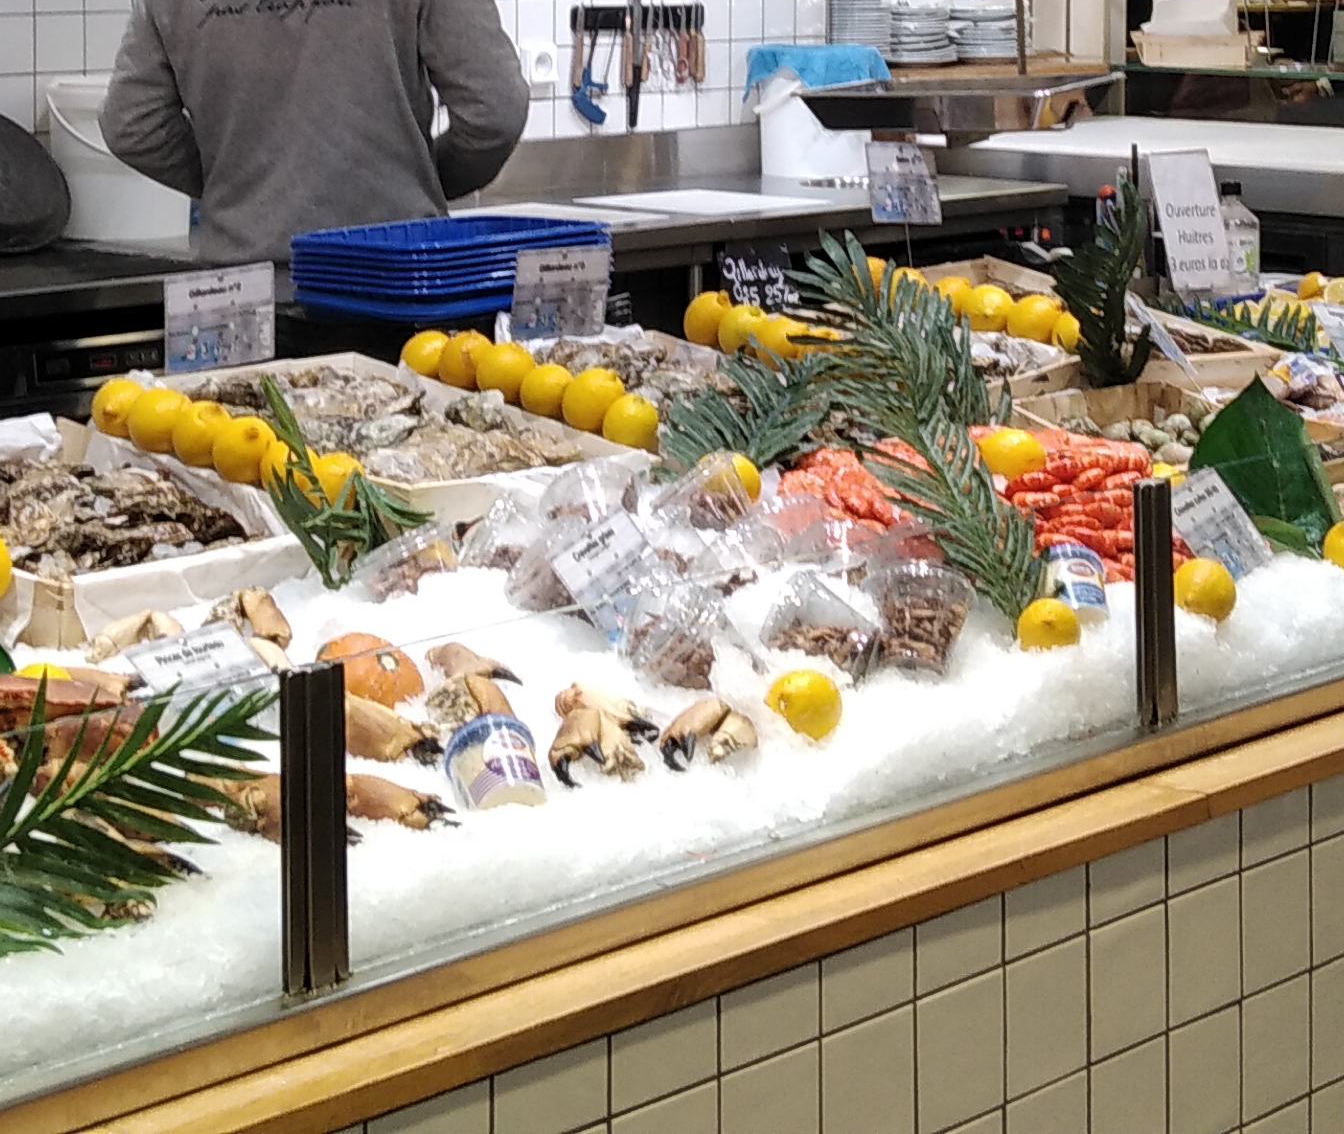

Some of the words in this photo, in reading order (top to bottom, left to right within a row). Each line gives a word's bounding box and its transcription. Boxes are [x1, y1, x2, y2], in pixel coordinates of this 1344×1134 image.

[1166, 203, 1216, 219] Ouverture
[1171, 256, 1177, 272] 3
[1179, 257, 1205, 272] euros
